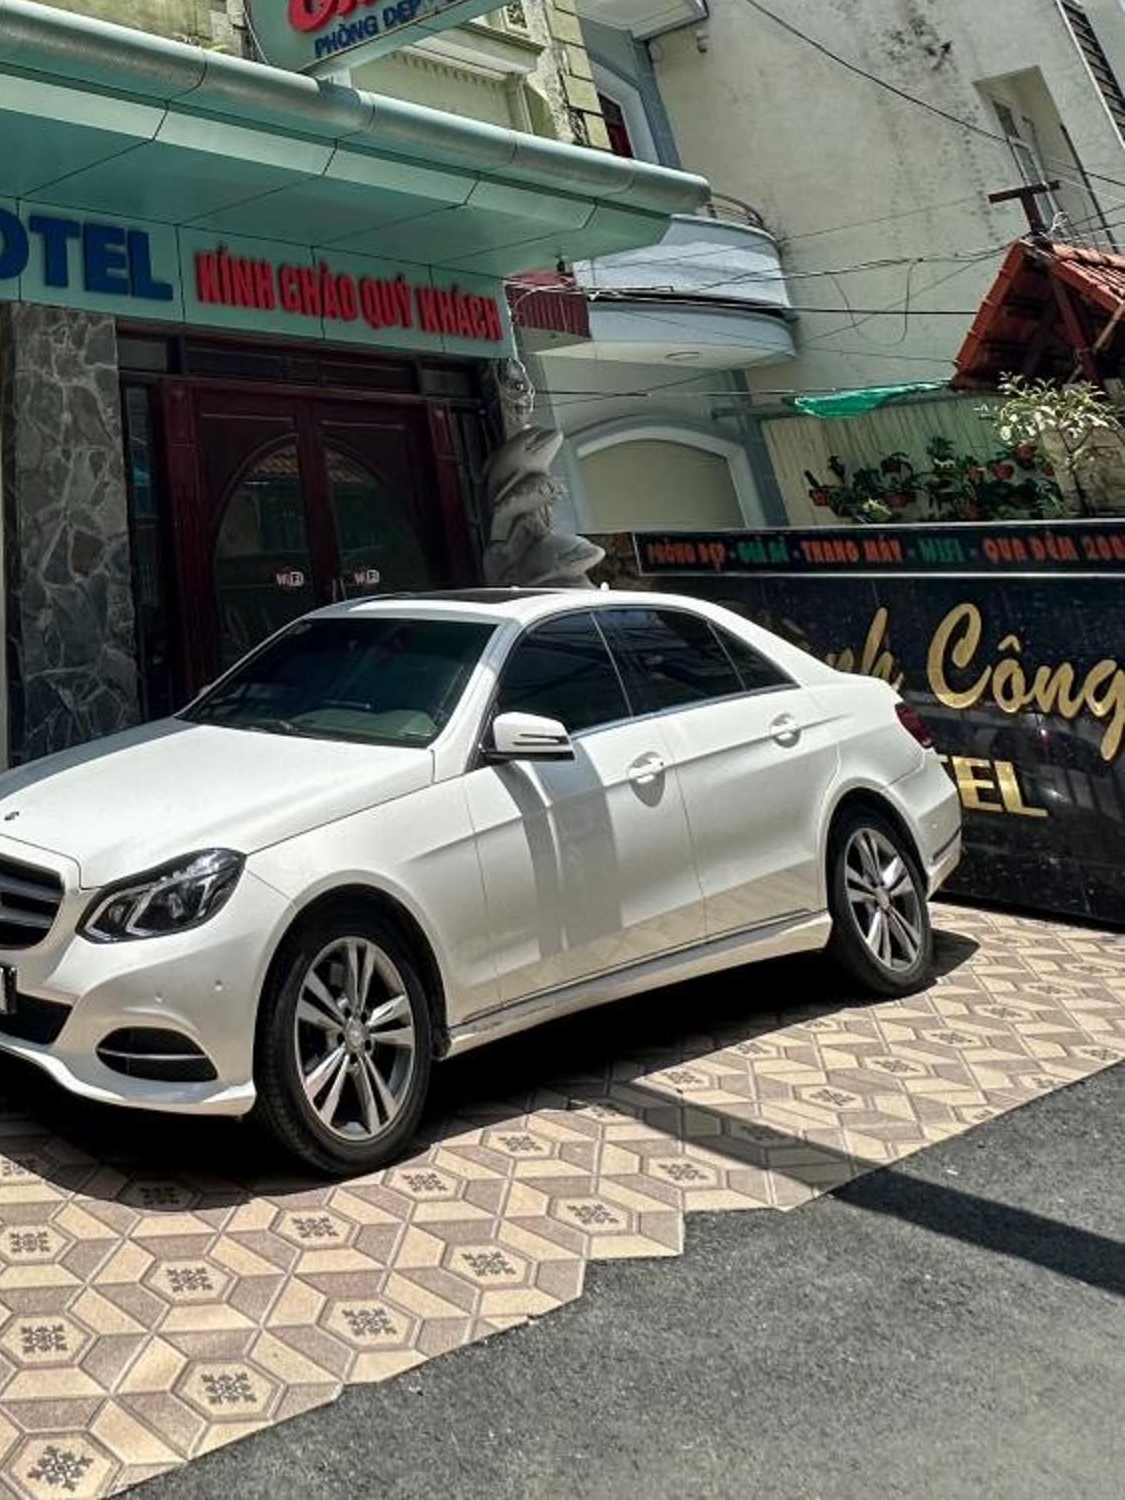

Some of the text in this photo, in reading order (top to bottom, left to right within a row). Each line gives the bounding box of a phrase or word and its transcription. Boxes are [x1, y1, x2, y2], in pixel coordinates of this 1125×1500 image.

[314, 14, 380, 58] PHÒNG
[194, 245, 276, 310] KÍNH
[278, 260, 358, 322] CHÀO
[361, 274, 414, 331] QUÝ
[416, 284, 504, 342] KHÁCH
